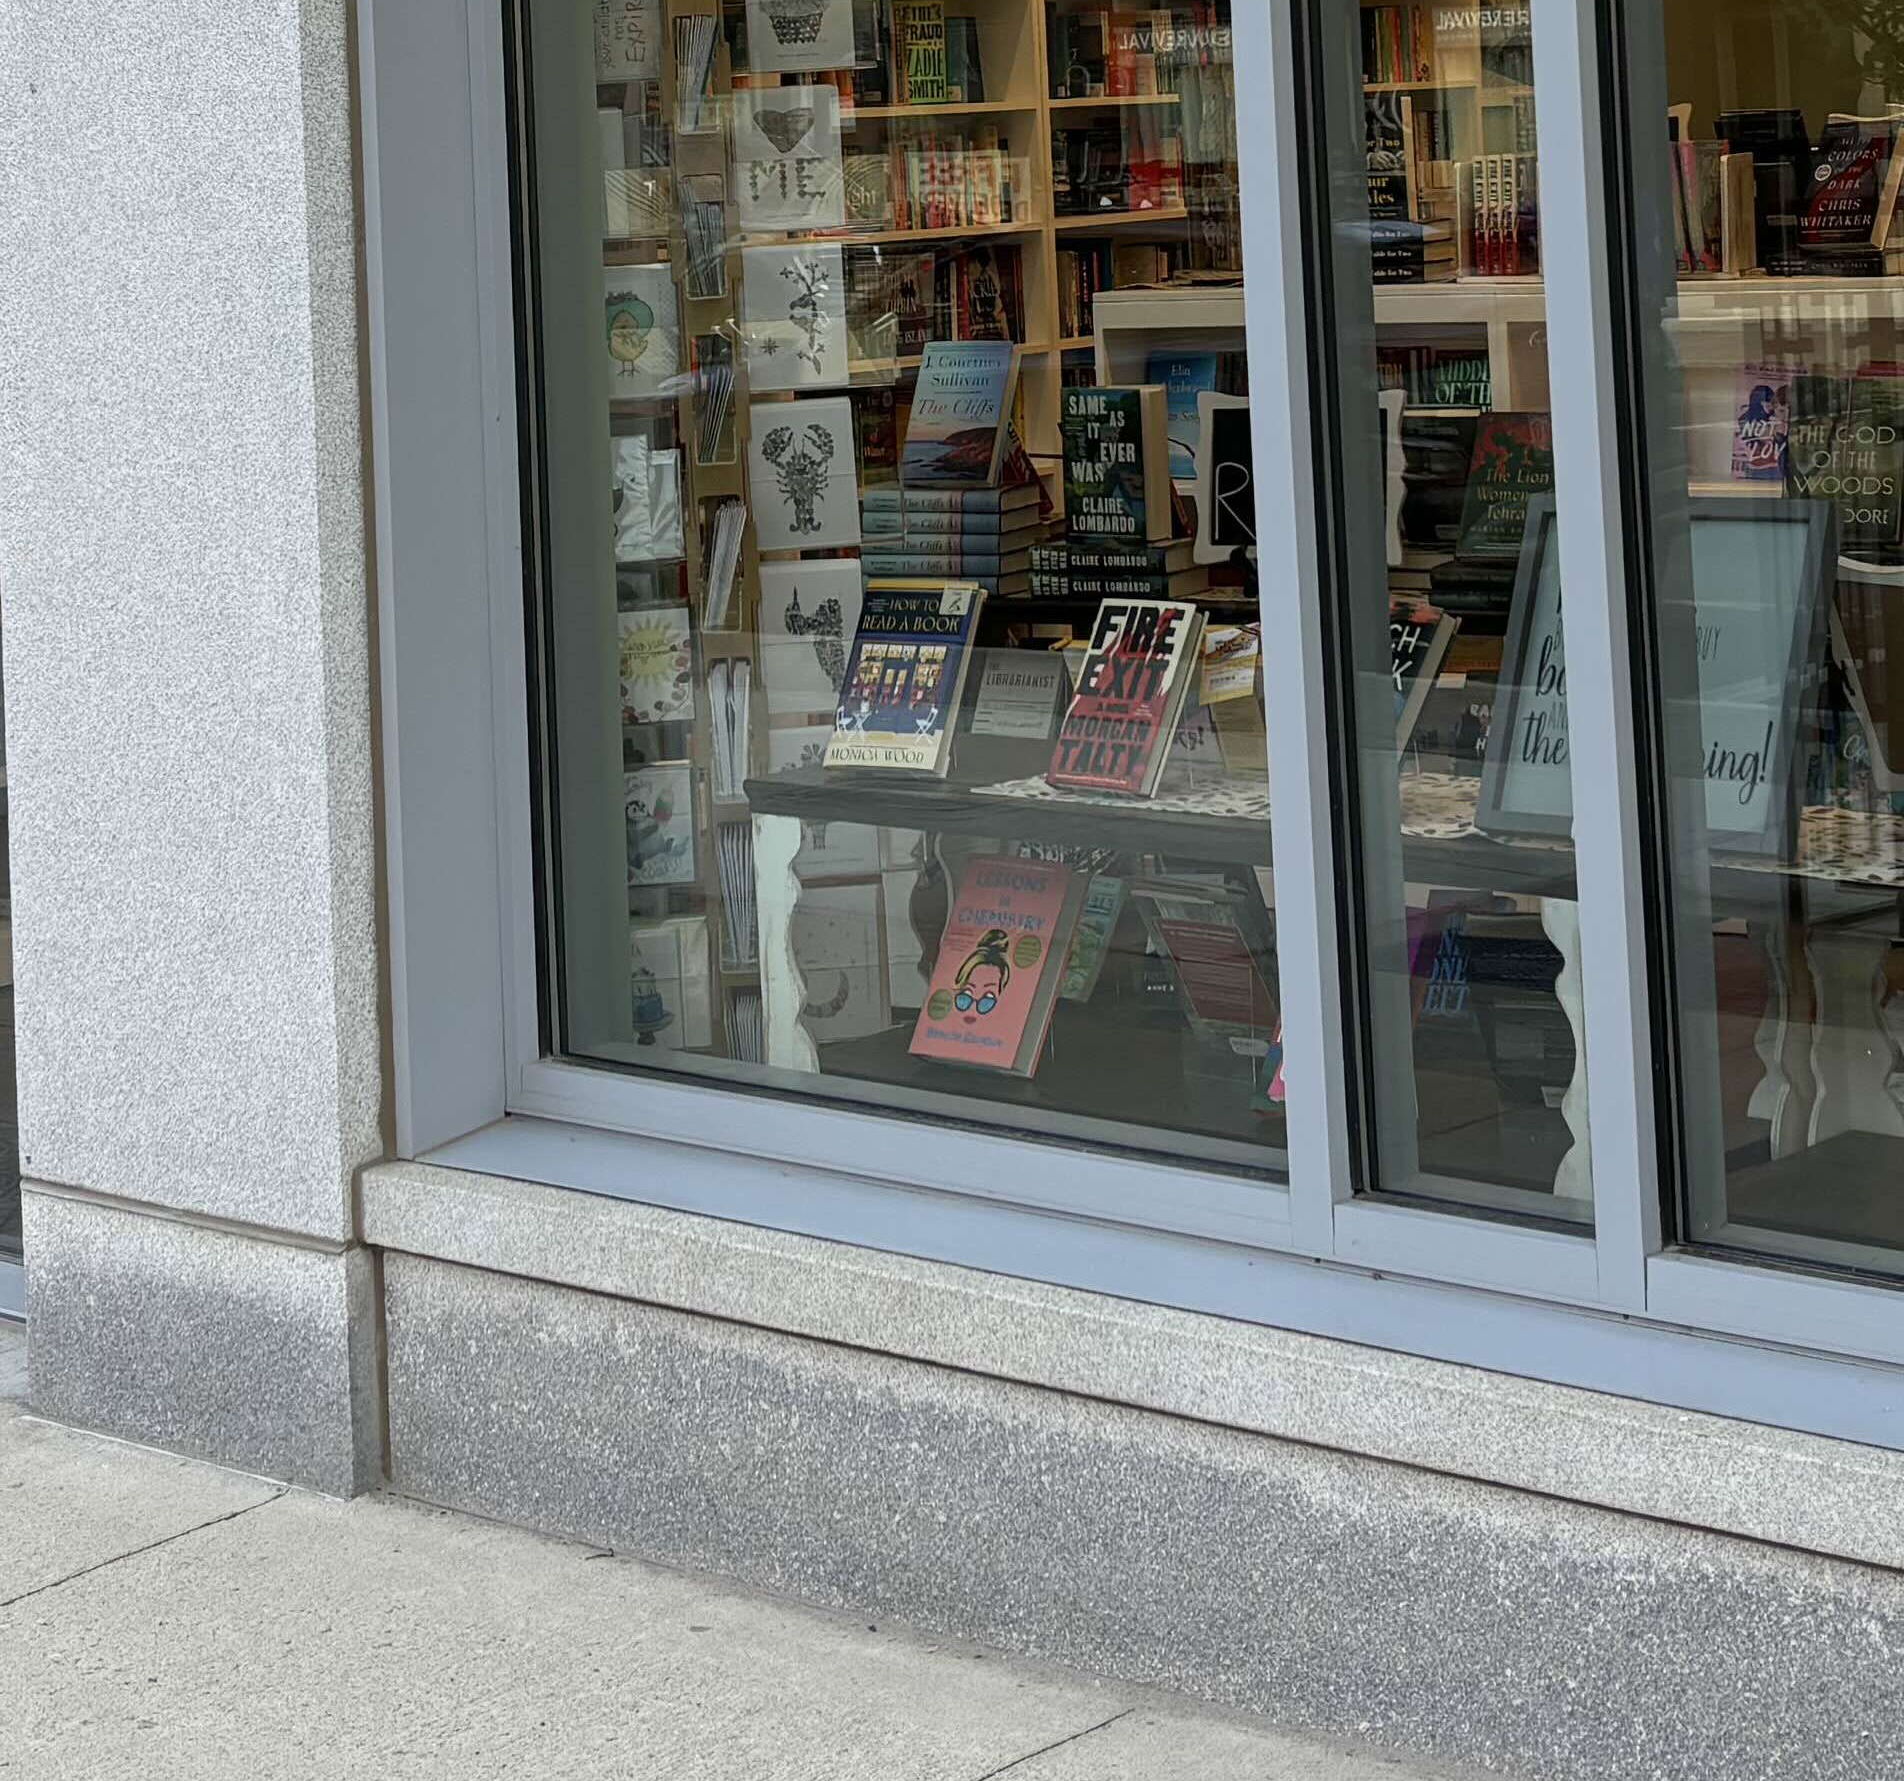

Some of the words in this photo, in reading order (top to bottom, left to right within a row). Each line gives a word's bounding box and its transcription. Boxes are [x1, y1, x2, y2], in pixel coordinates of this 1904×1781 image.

[1818, 199, 1862, 212] CHRIS
[1800, 215, 1872, 228] WHITAKER
[1069, 395, 1108, 415] SAME
[1110, 410, 1125, 428] AS
[1087, 422, 1100, 440] IT
[1741, 420, 1777, 438] NOT
[1799, 424, 1825, 445] THE
[1835, 426, 1896, 445] GOD
[1100, 442, 1136, 463] EVER
[1748, 442, 1785, 460] LOV
[1812, 450, 1841, 469] OF
[1848, 450, 1878, 469] THE
[1071, 461, 1105, 483] WAS
[1517, 468, 1550, 485] Lion
[1794, 476, 1895, 496] WOODS
[1082, 496, 1125, 514] CLAIRE
[1488, 505, 1526, 520] Tehra
[1072, 514, 1136, 533] LOMBARDO
[889, 598, 922, 612] HOW
[922, 598, 940, 613] TO
[861, 614, 897, 631] READ
[897, 615, 911, 633] A
[912, 616, 961, 633] BOOK
[1091, 604, 1186, 655] FIRE
[1076, 653, 1170, 706] EXIT
[1064, 715, 1152, 738] MORGAN
[831, 747, 879, 762] MONICA
[883, 749, 925, 764] WOOD
[1059, 738, 1144, 774] TALTY
